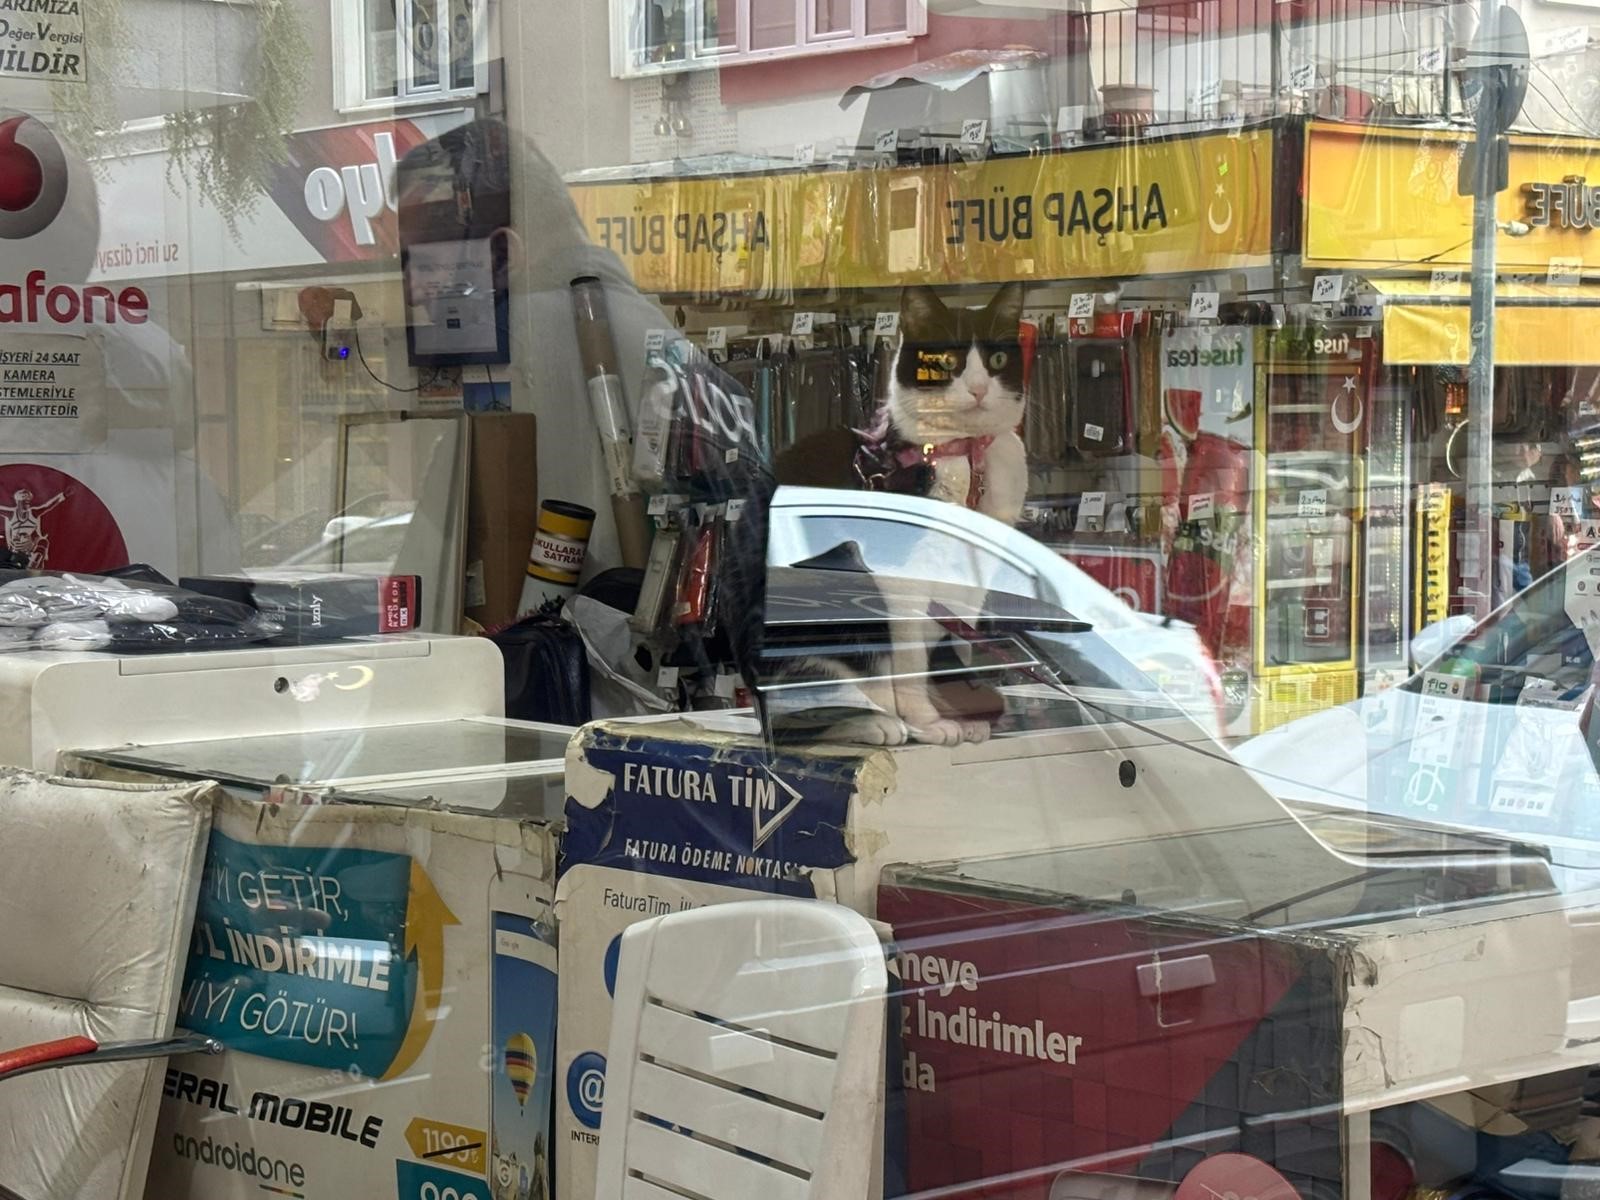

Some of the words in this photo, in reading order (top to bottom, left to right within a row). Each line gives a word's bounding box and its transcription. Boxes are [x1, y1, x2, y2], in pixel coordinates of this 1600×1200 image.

[37, 22, 83, 45] Vergisi
[0, 44, 79, 76] İLDİR
[4, 370, 55, 381] KAMERA
[36, 353, 49, 364] 24
[52, 353, 80, 364] SAAT
[623, 762, 718, 803] FATURA
[727, 768, 777, 811] TİM
[624, 838, 677, 863] FATURA
[681, 841, 732, 872] ÖDEME
[735, 854, 799, 880] NOKTAS
[237, 866, 349, 922] GETİR,
[222, 916, 391, 992] İNDİRİMLE
[239, 988, 360, 1051] GÖTÜR!
[916, 987, 1083, 1066] İndirimler
[248, 1091, 385, 1150] MOBILE
[570, 1129, 600, 1146] INTER
